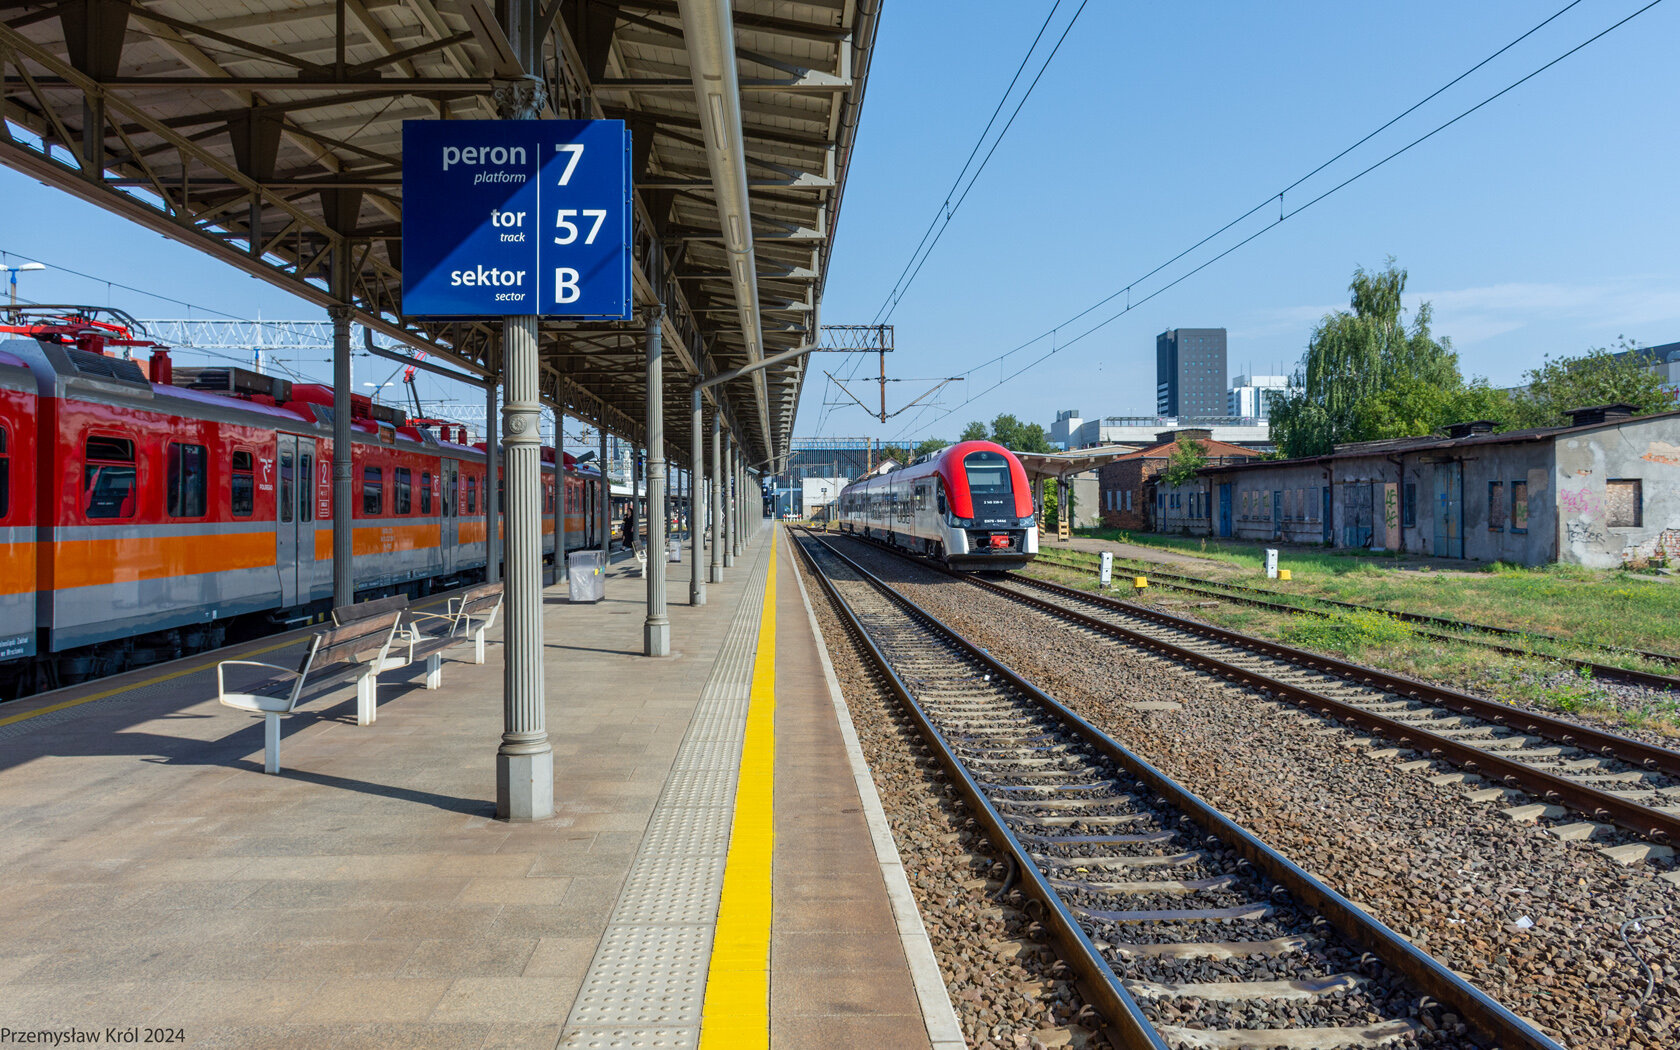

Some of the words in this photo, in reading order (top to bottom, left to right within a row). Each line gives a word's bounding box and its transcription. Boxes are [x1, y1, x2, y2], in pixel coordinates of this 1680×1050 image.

[443, 146, 526, 172] peron
[555, 143, 585, 186] 7
[474, 170, 526, 185] platform
[491, 209, 526, 227] tor
[554, 209, 607, 245] 57
[500, 231, 526, 242] track
[450, 265, 526, 287] sektor
[555, 267, 581, 304] B
[495, 291, 526, 301] sector
[321, 463, 327, 484] 2
